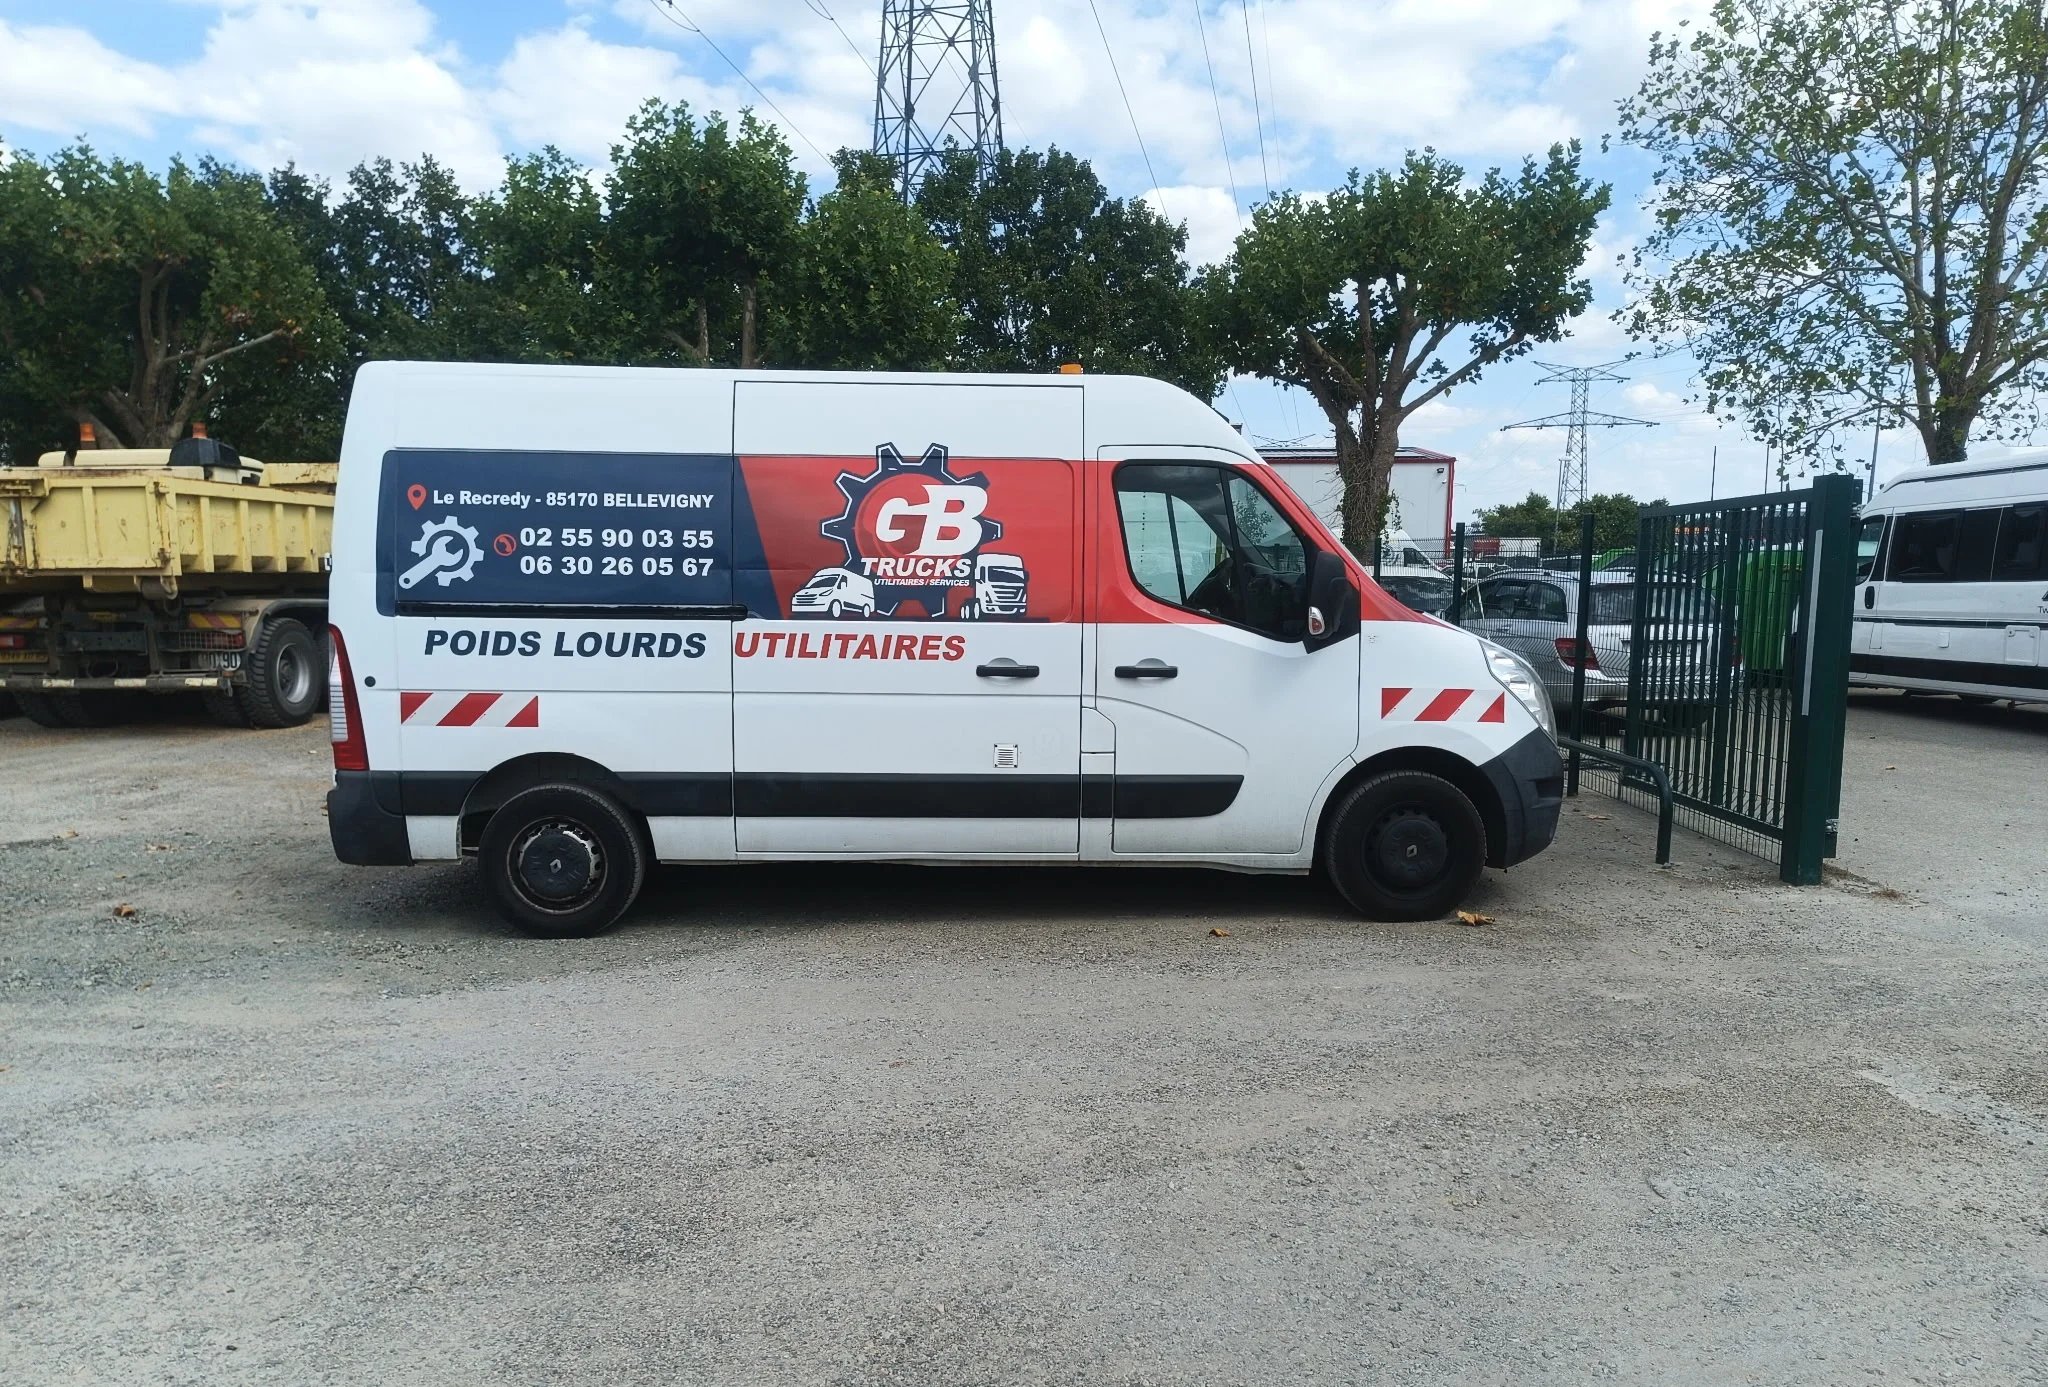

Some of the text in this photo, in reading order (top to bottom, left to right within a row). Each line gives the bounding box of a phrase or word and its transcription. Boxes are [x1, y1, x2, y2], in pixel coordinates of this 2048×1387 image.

[433, 490, 455, 505] Le
[460, 490, 531, 509] Recredy
[546, 491, 598, 507] 85170
[603, 492, 715, 508] BELLEVIGNY
[875, 484, 988, 556] GB
[520, 527, 714, 548] 02 55 90 03 55
[520, 555, 714, 577] 06 30 26 05 67
[861, 557, 972, 578] TRUCKS
[874, 578, 925, 587] UTILITAIRES
[929, 579, 970, 587] SERVICES
[424, 630, 966, 661] POIDS LOURDS UTILITAIRES
